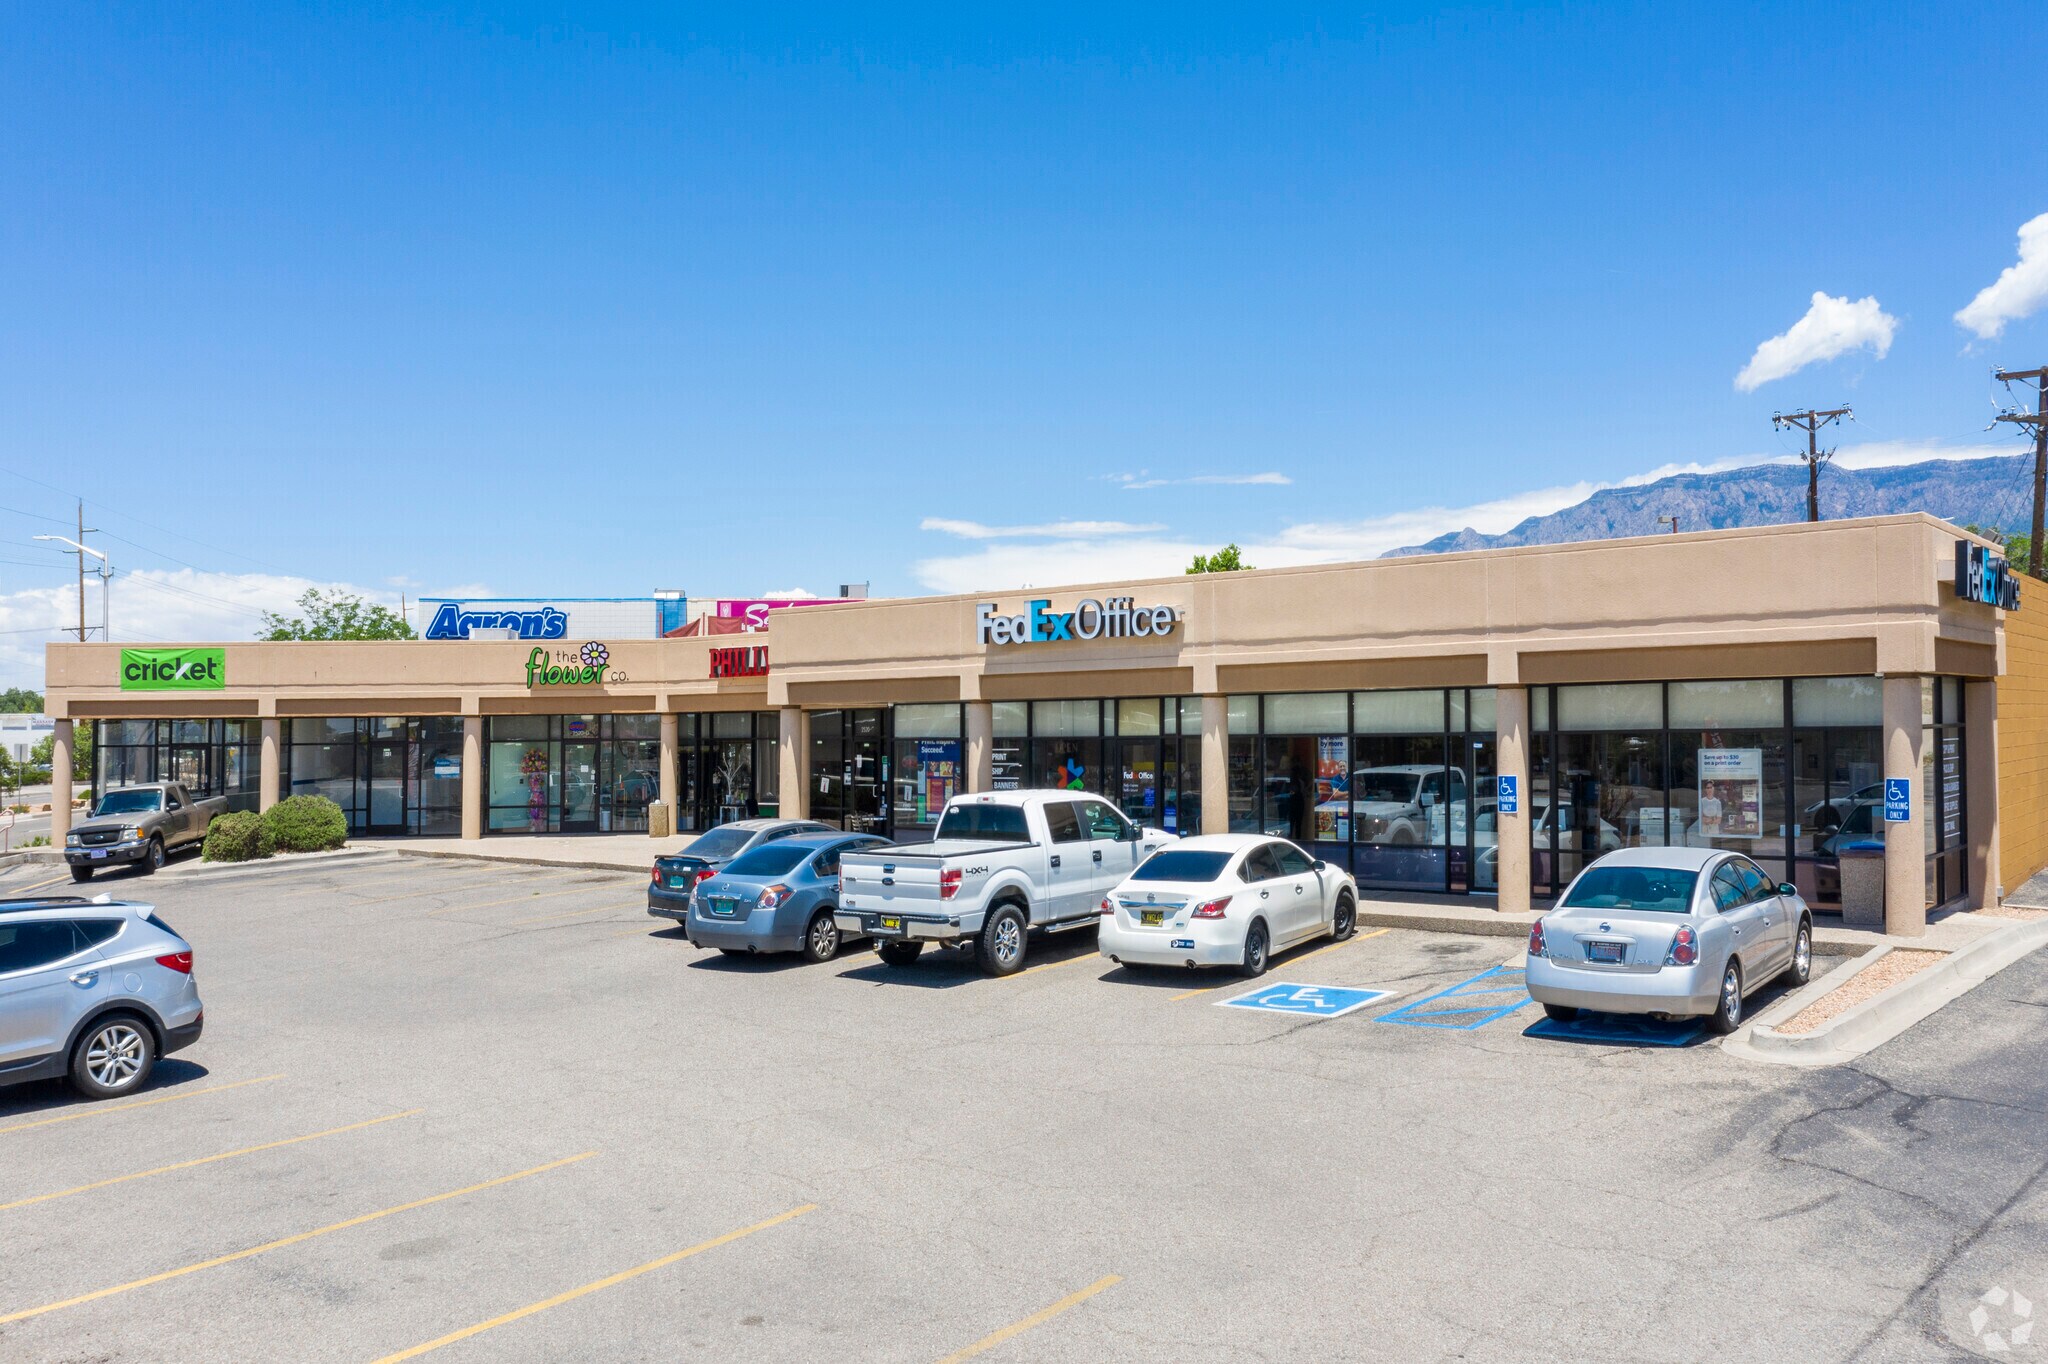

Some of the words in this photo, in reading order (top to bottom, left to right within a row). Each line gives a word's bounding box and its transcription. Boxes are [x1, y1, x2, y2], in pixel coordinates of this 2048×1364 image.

[426, 604, 568, 639] Aaron's
[976, 599, 1075, 645] FedEx
[1075, 597, 1175, 640] Office
[525, 647, 610, 689] flower
[556, 650, 578, 663] the
[125, 658, 217, 681] cricket
[1886, 802, 1909, 810] PARKING
[1890, 811, 1903, 819] ONLY
